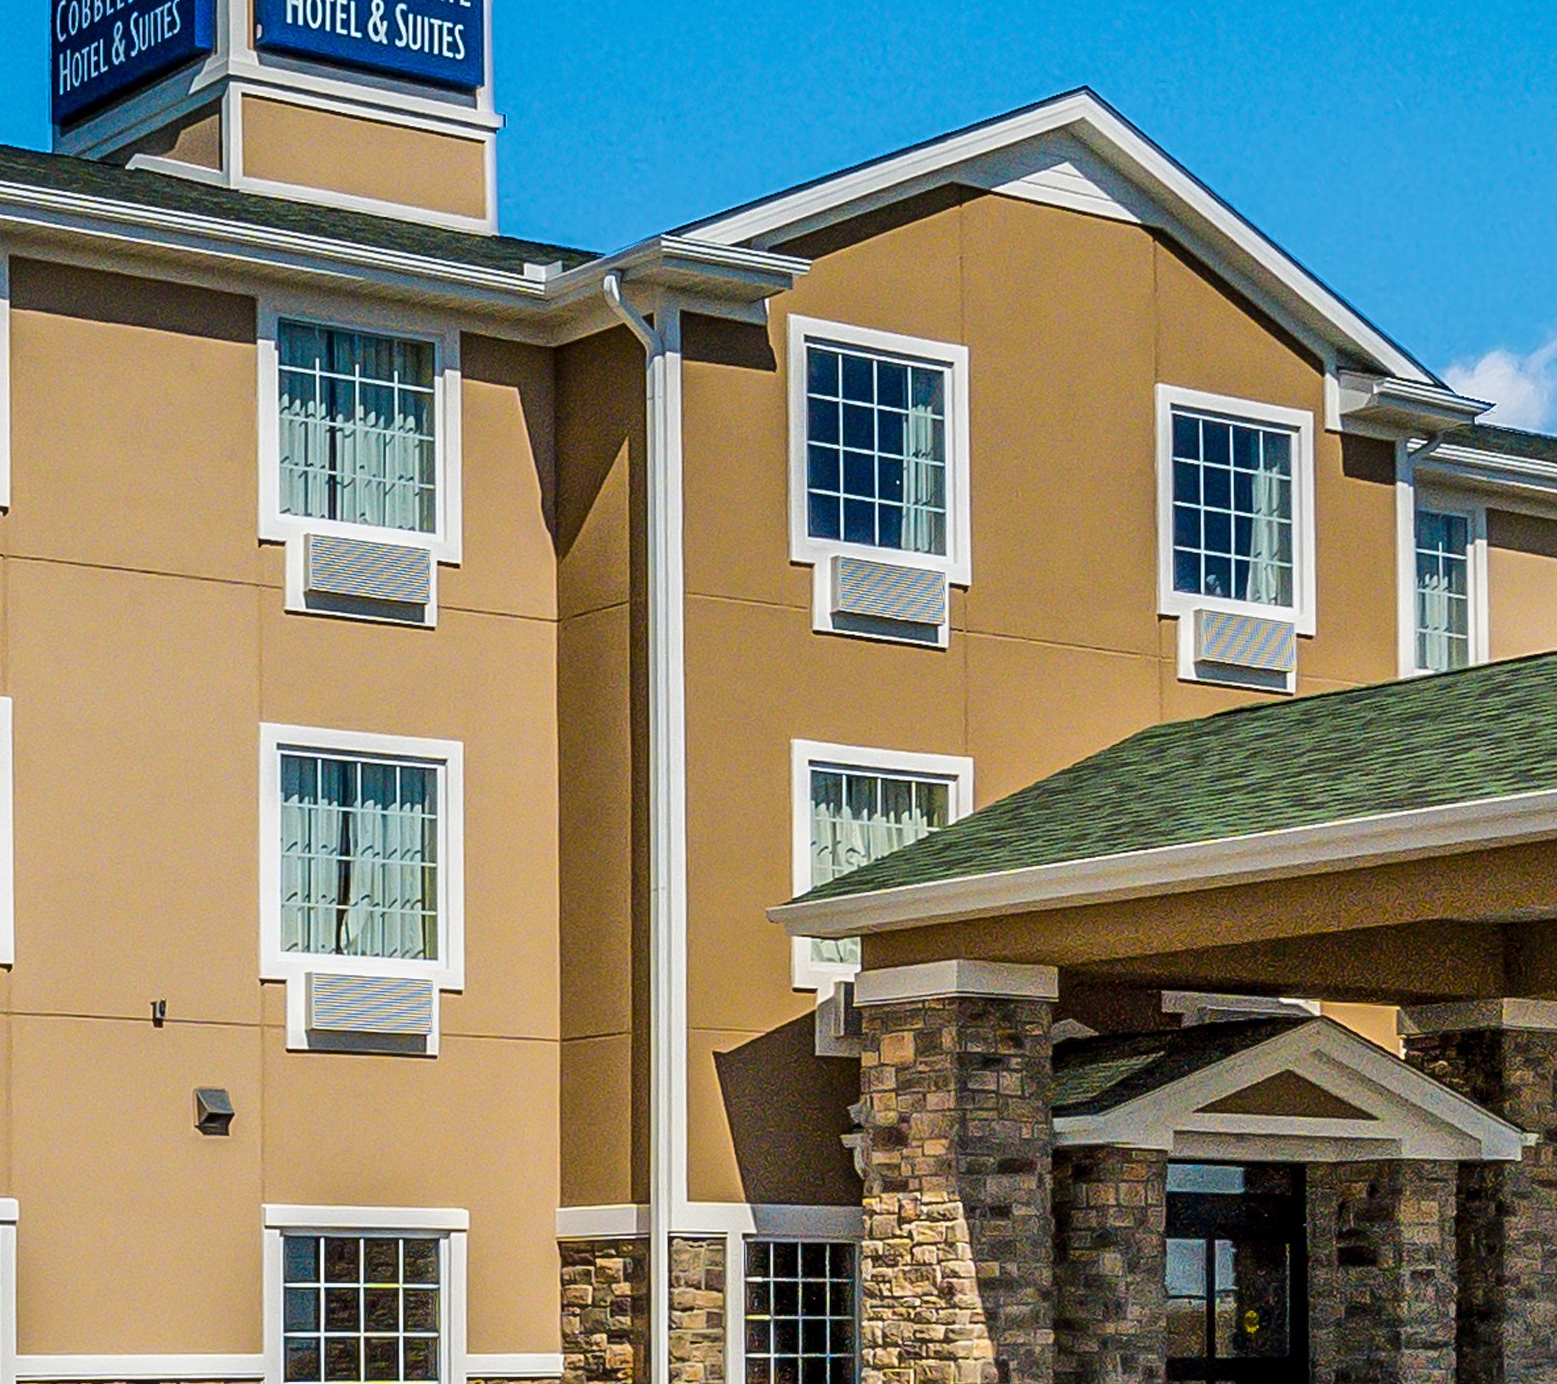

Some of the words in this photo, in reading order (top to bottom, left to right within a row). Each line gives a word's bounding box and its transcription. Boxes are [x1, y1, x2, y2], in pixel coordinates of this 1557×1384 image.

[58, 40, 109, 95] HOTEL
[111, 22, 126, 64] &
[394, 3, 466, 60] SUITES
